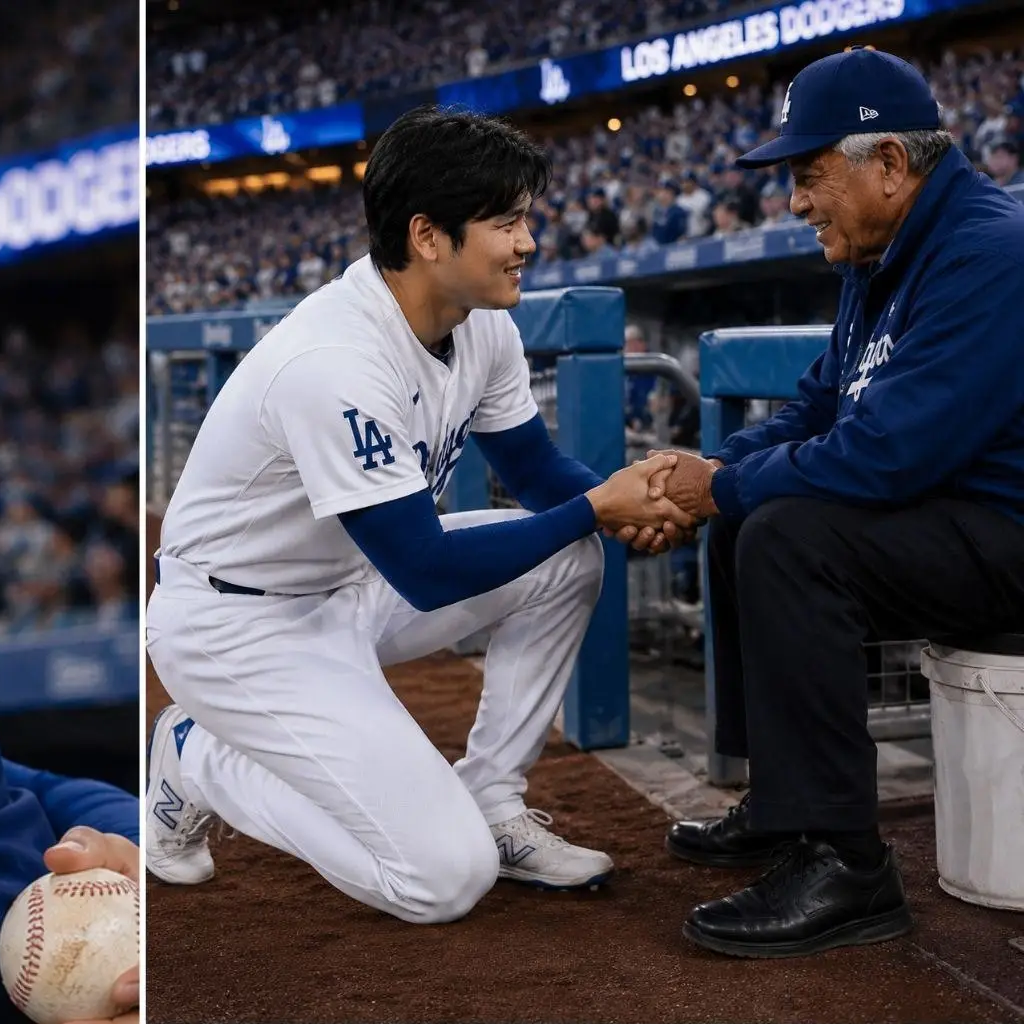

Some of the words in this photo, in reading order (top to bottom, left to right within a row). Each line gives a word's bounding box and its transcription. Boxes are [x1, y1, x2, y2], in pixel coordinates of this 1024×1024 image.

[620, 38, 670, 81] LOS
[671, 11, 779, 71] ANGELES
[343, 408, 396, 471] LA
